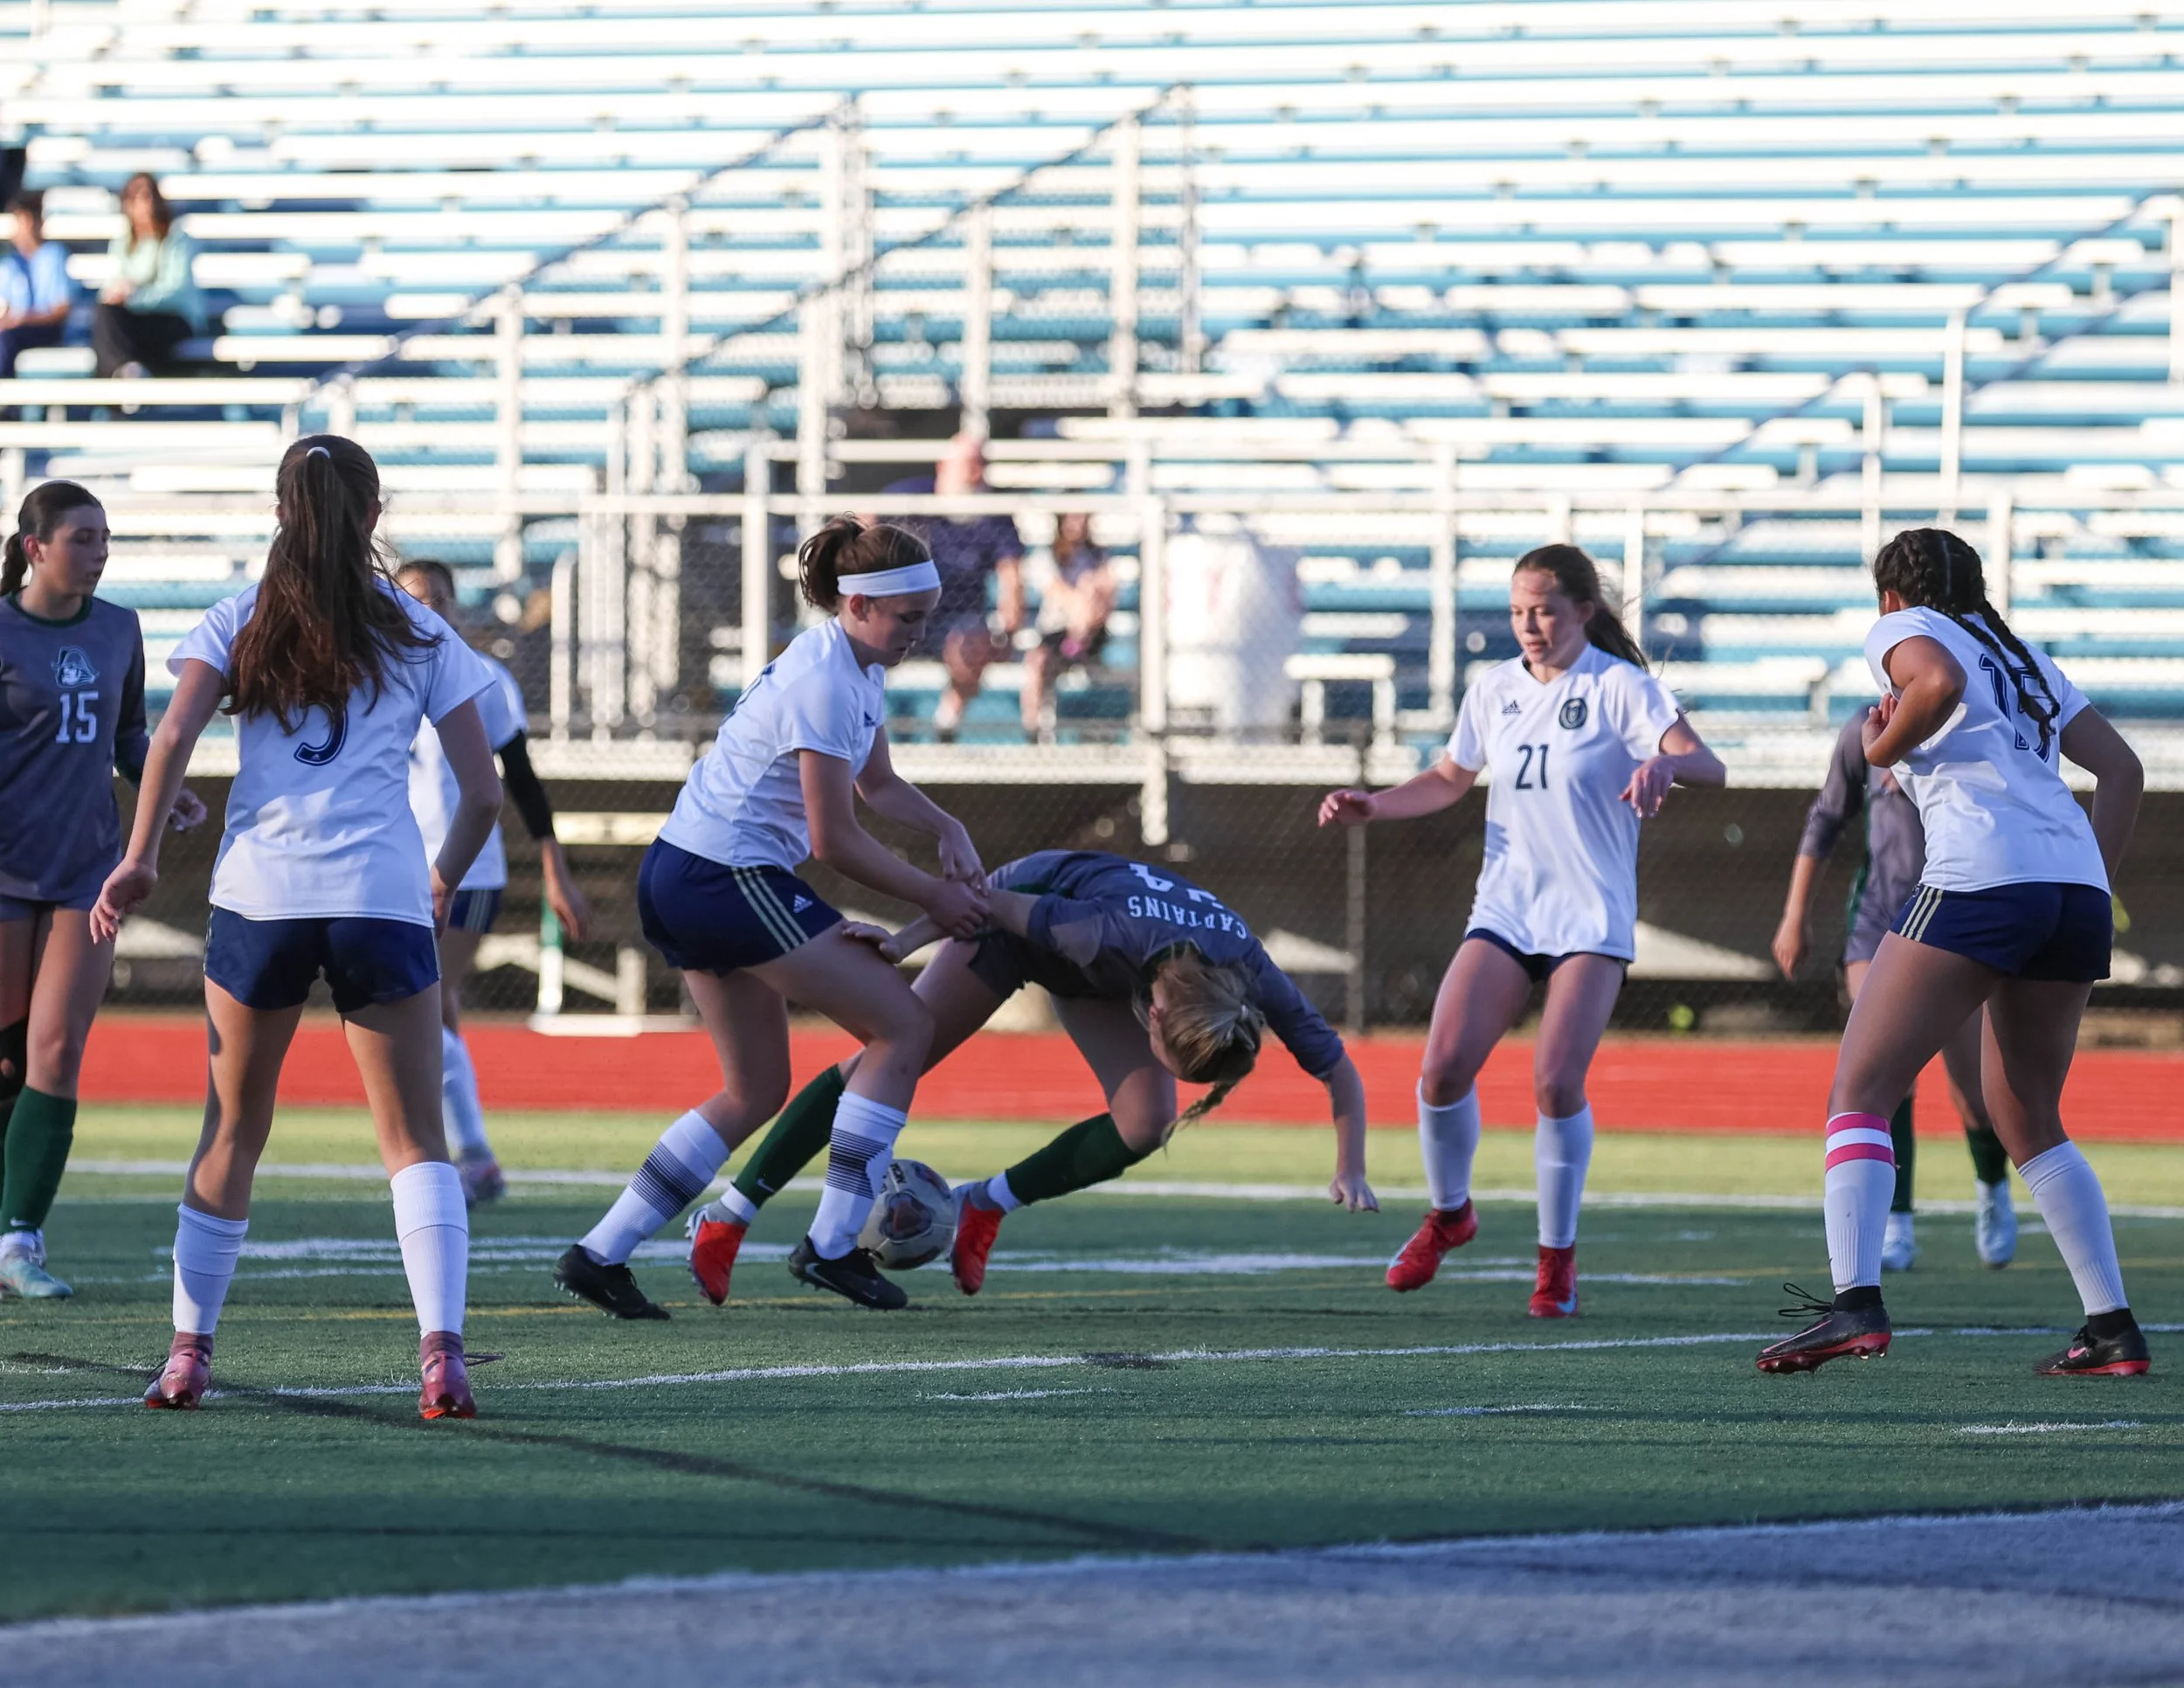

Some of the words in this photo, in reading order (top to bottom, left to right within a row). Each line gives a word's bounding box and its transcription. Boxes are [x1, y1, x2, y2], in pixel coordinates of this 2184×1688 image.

[55, 690, 99, 744] 15
[1515, 744, 1550, 790] 21
[1128, 896, 1248, 940] CAPTAINS
